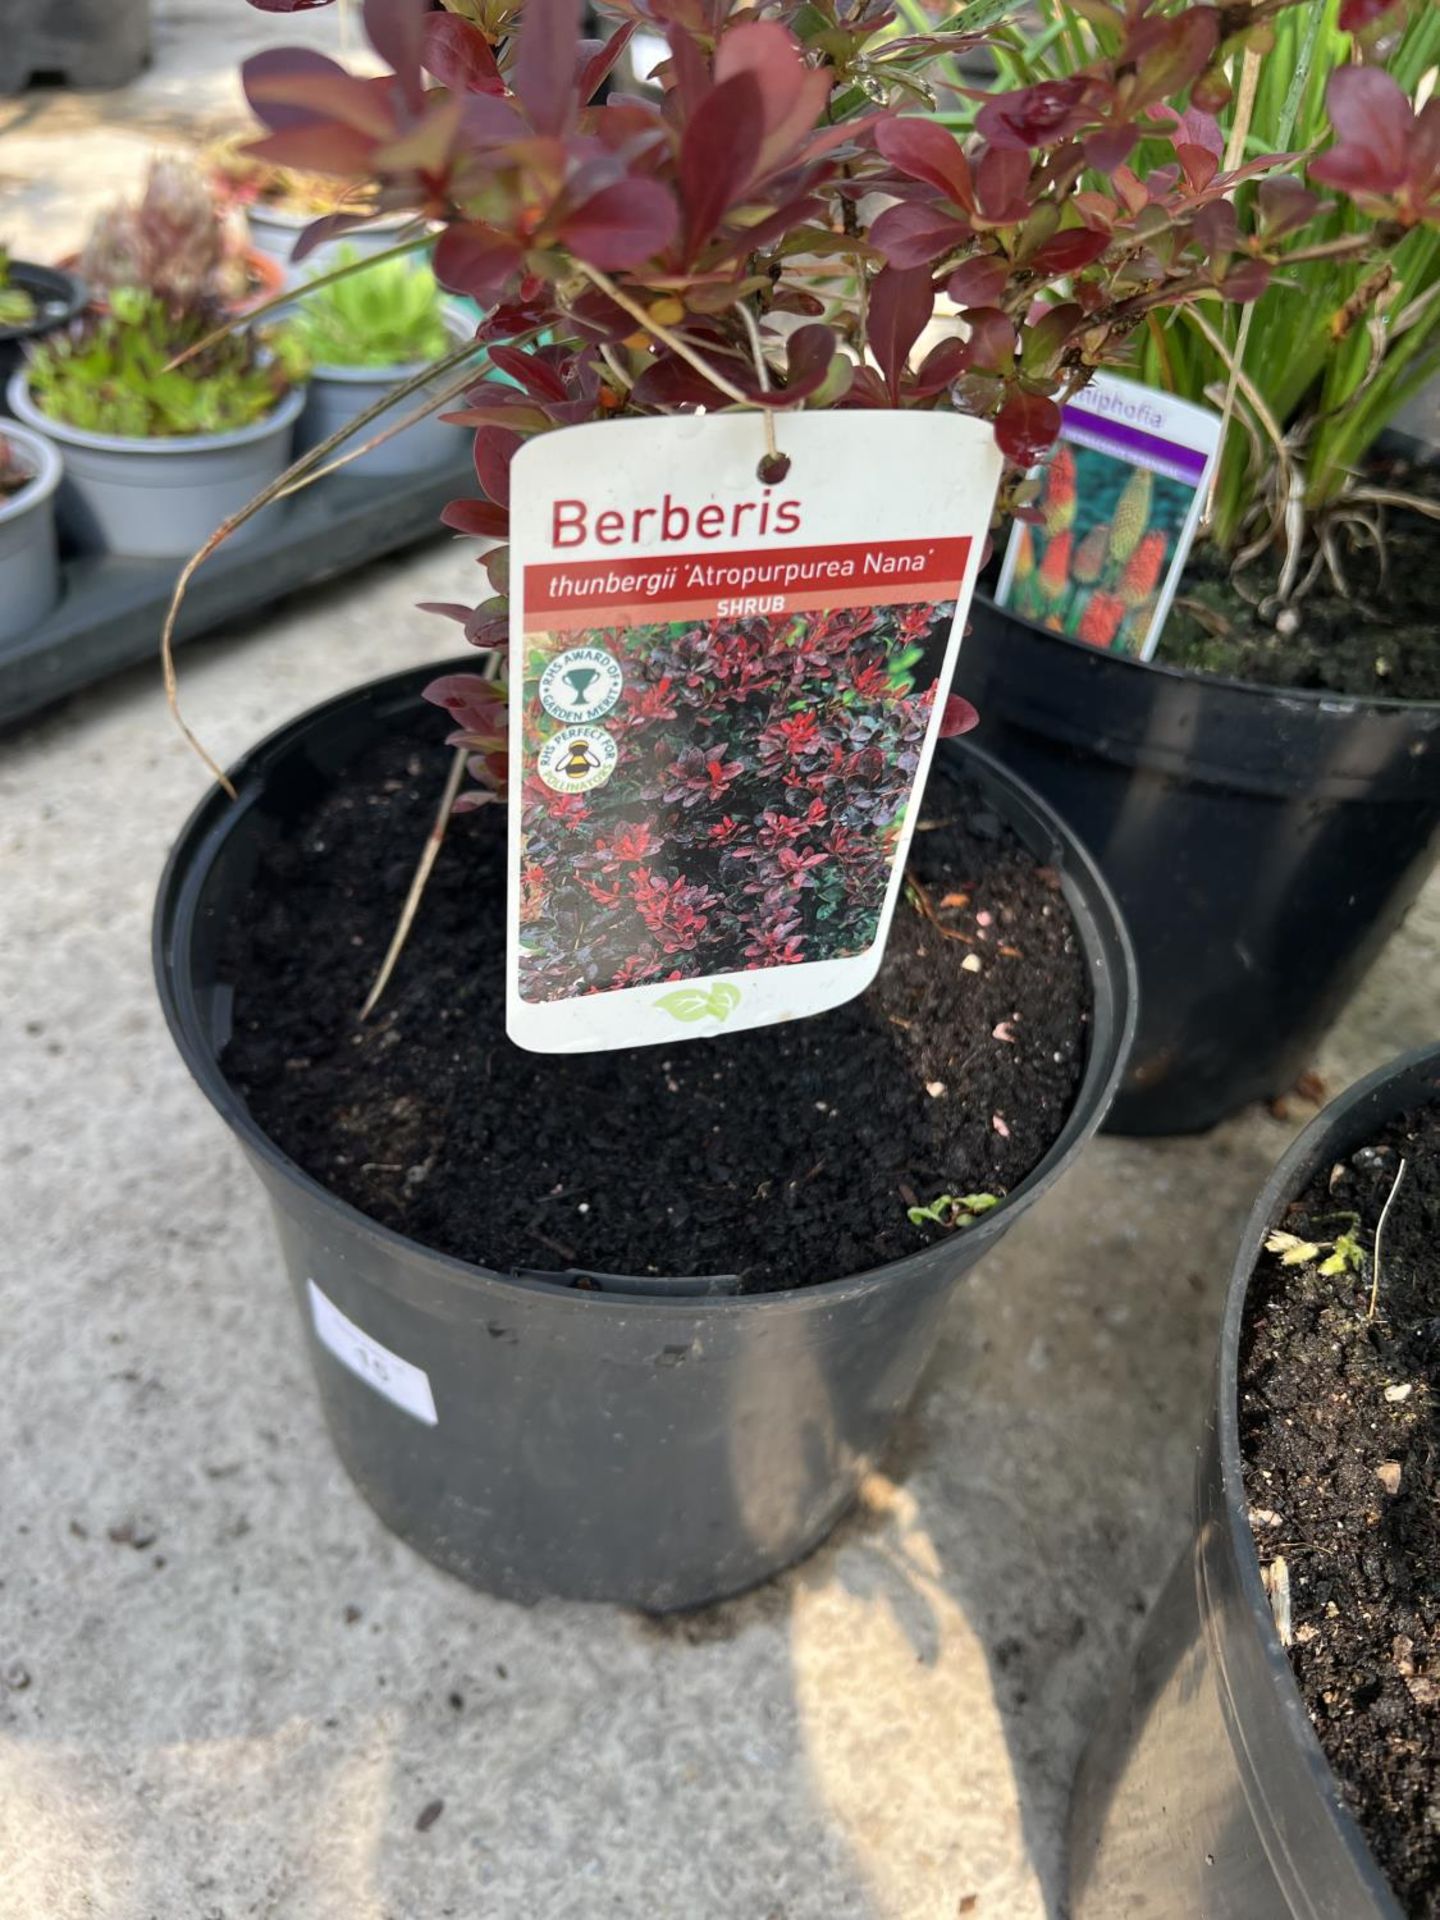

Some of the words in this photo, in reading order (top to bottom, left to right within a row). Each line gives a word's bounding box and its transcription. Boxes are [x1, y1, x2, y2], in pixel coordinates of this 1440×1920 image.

[1074, 388, 1163, 429] niphofia
[552, 489, 802, 549] Berberis
[549, 566, 679, 598] thunbergii
[716, 595, 785, 617] SHRUB
[543, 662, 563, 686] RHS
[564, 650, 611, 667] AWARD
[607, 665, 620, 679] OF
[543, 694, 583, 721] GARDEN
[587, 688, 619, 719] MERIT
[540, 745, 556, 766] RHS
[554, 727, 606, 745] PERFECT
[602, 739, 616, 760] FOR
